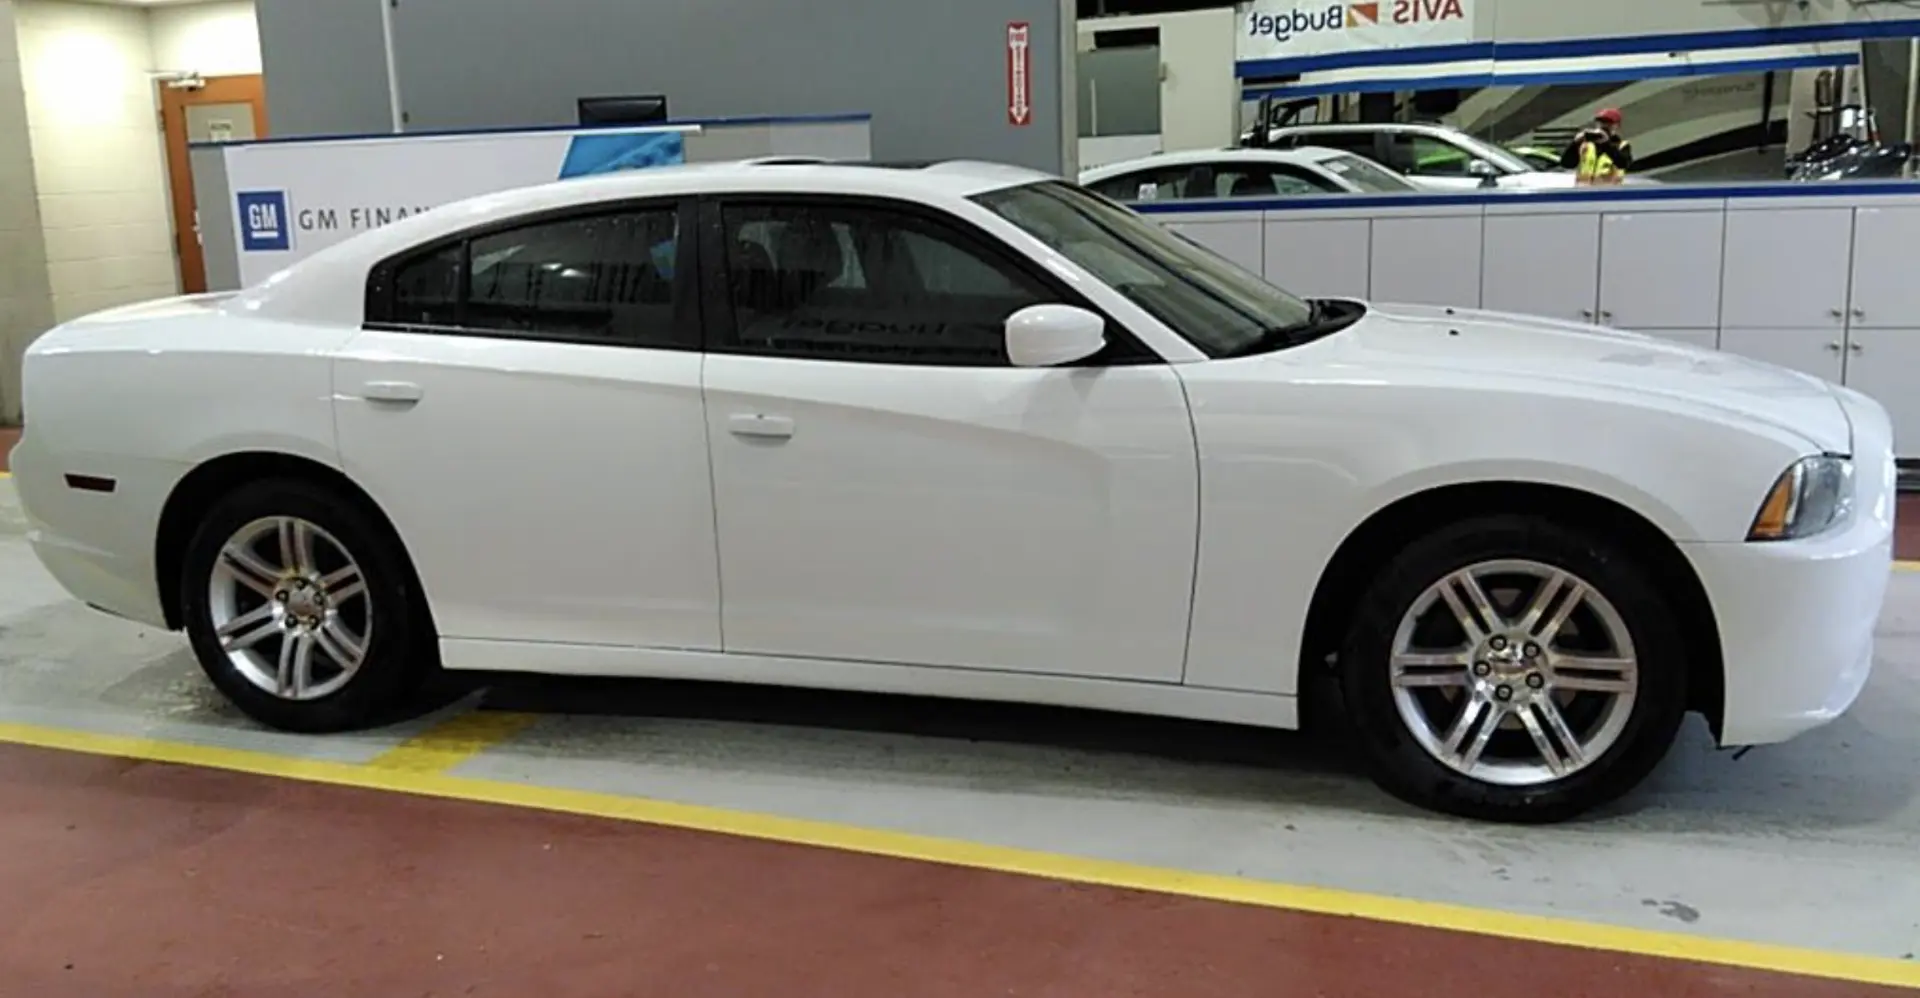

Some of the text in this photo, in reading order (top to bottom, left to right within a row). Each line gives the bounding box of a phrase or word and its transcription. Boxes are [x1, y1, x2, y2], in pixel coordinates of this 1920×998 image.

[247, 203, 278, 230] GM
[298, 205, 430, 232] GM FINA
